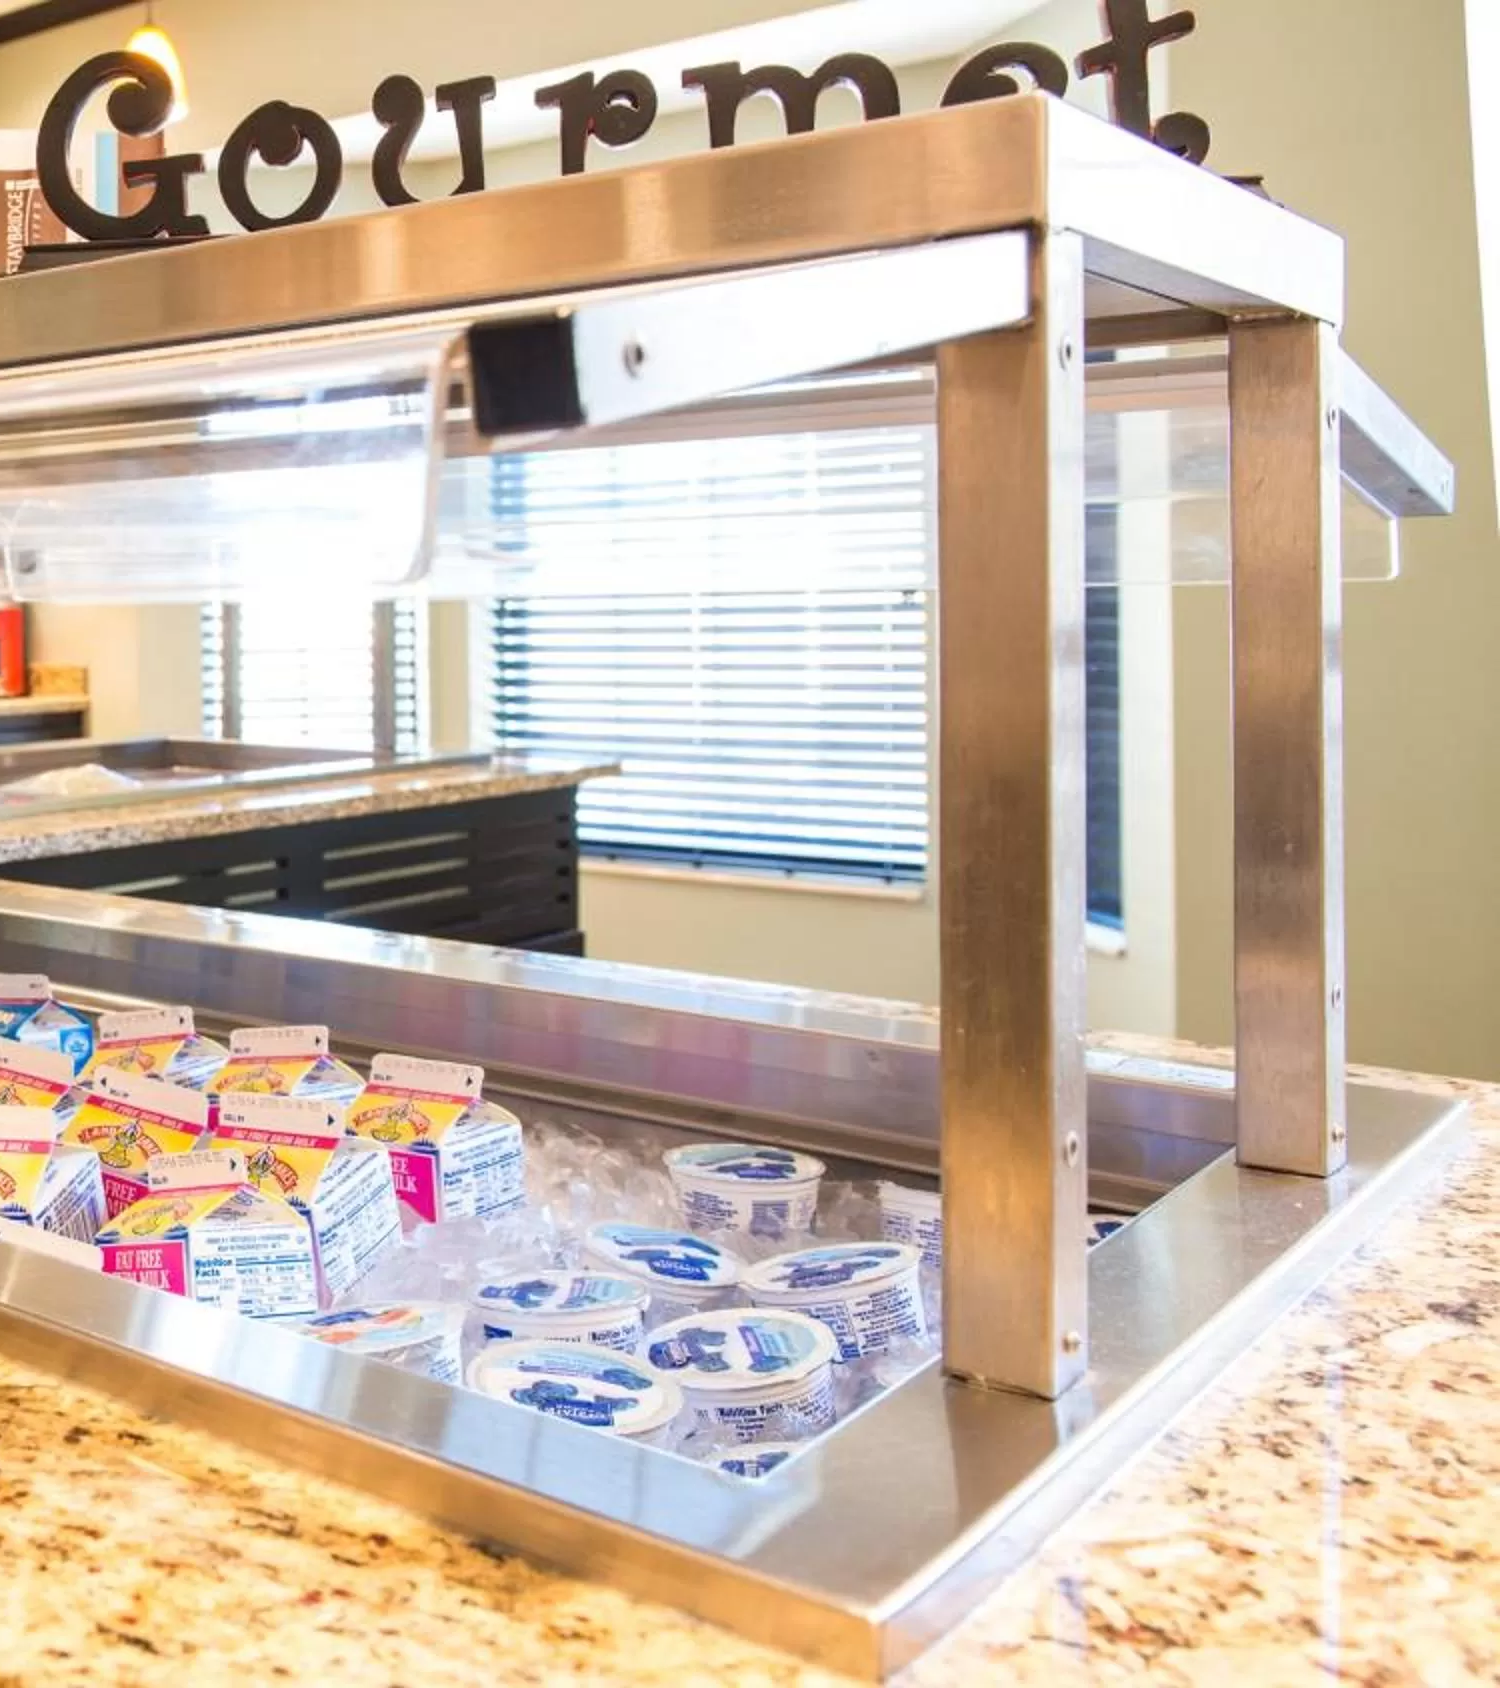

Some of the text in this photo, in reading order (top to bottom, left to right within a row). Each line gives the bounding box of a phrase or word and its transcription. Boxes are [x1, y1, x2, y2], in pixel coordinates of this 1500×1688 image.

[106, 1180, 137, 1200] FREE
[115, 1248, 164, 1271] FAT FREE
[195, 1257, 233, 1268] Nutrition
[195, 1268, 220, 1278] Facts
